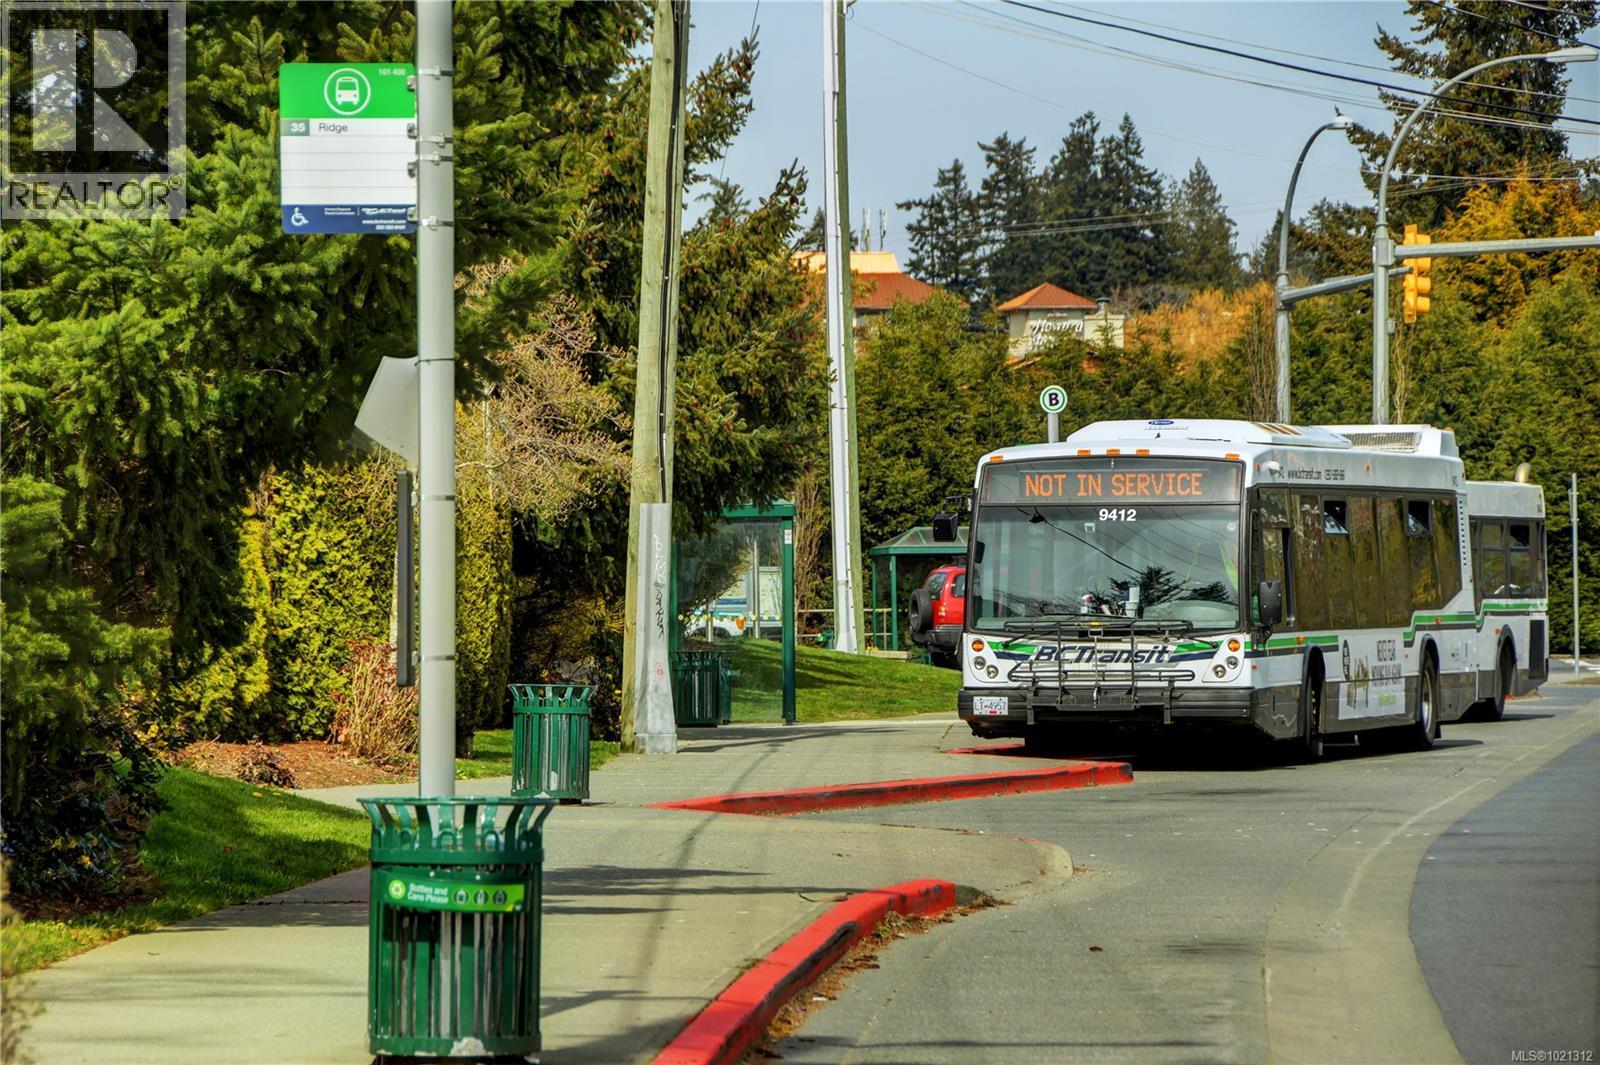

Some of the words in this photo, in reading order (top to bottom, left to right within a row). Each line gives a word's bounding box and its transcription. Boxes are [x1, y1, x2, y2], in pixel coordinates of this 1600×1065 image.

[318, 122, 348, 134] Ridge
[1048, 392, 1060, 407] B
[1025, 473, 1067, 497] NOT
[1077, 473, 1102, 497] IN
[1111, 472, 1203, 497] SERVICE
[1098, 508, 1137, 522] 9412
[434, 887, 449, 896] and
